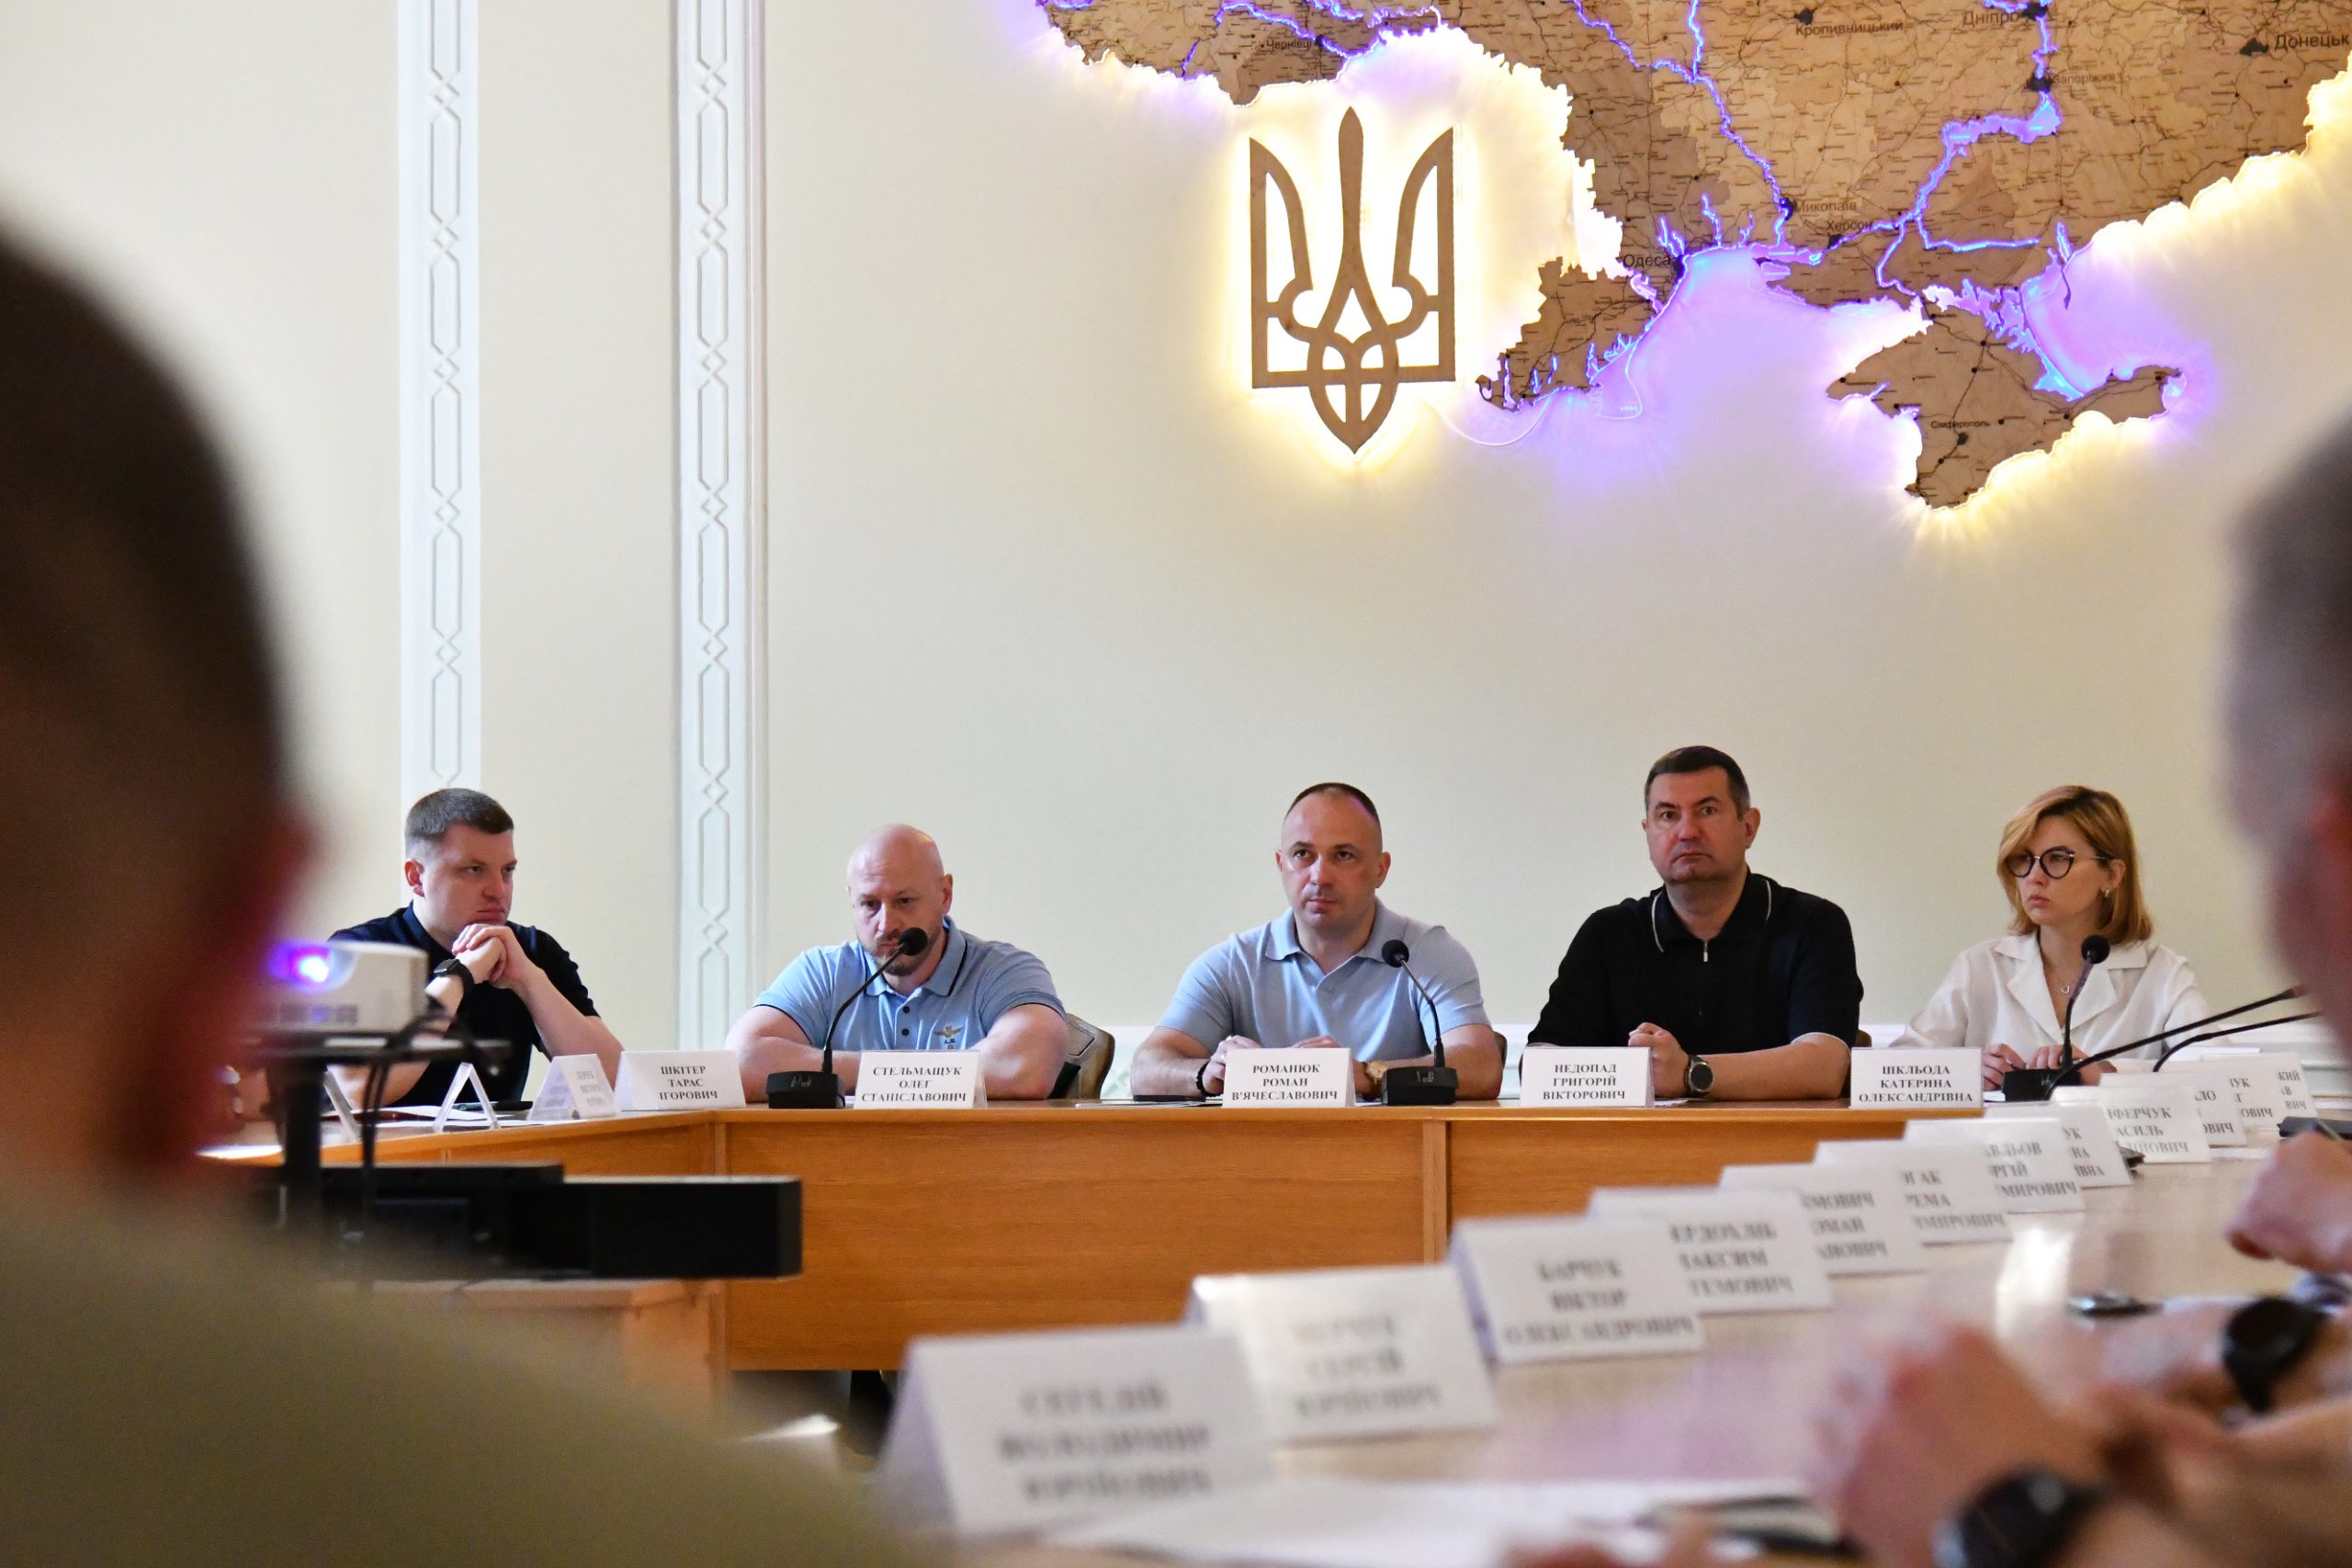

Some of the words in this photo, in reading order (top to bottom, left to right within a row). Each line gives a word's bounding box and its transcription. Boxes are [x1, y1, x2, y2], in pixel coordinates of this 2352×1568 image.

[1962, 10, 2019, 28] Дніпро
[1795, 20, 1904, 38] Кропивницький
[1266, 39, 1312, 51] Чернівці
[2275, 33, 2350, 53] Донецьк
[1826, 220, 1873, 232] Херсон
[1623, 254, 1671, 269] Одеса
[660, 1066, 707, 1075] ШКІТЕР
[873, 1066, 963, 1077] СТЕЛЬМАЩУК
[1252, 1064, 1321, 1074] РОМАНЮК
[1554, 1064, 1618, 1074] НЕДОПАД
[1882, 1066, 1951, 1075] ШКЛЬОДА
[2278, 1069, 2301, 1081] КИЙ
[667, 1078, 705, 1088] ТАРАС
[899, 1079, 933, 1089] ОЛЕГ
[1262, 1077, 1308, 1087] РОМАН
[1553, 1076, 1617, 1087] ГРИГОРІЙ
[1880, 1079, 1952, 1089] КАТЕРИНА
[659, 1090, 718, 1100] ІГОРОВИЧ
[861, 1092, 967, 1102] СТАНІСЛАВОВИЧ
[1231, 1090, 1338, 1100] В'ЯЧЕСЛАВОВИЧ
[1543, 1090, 1625, 1100] ВІКТОРОВИЧ
[1859, 1092, 1973, 1102] ОЛЕКСАНДРІВНА
[2107, 1108, 2172, 1120] ФЕРЧУК
[2241, 1108, 2273, 1118] ОВИЧ
[2117, 1124, 2165, 1137] АСИЛЬ
